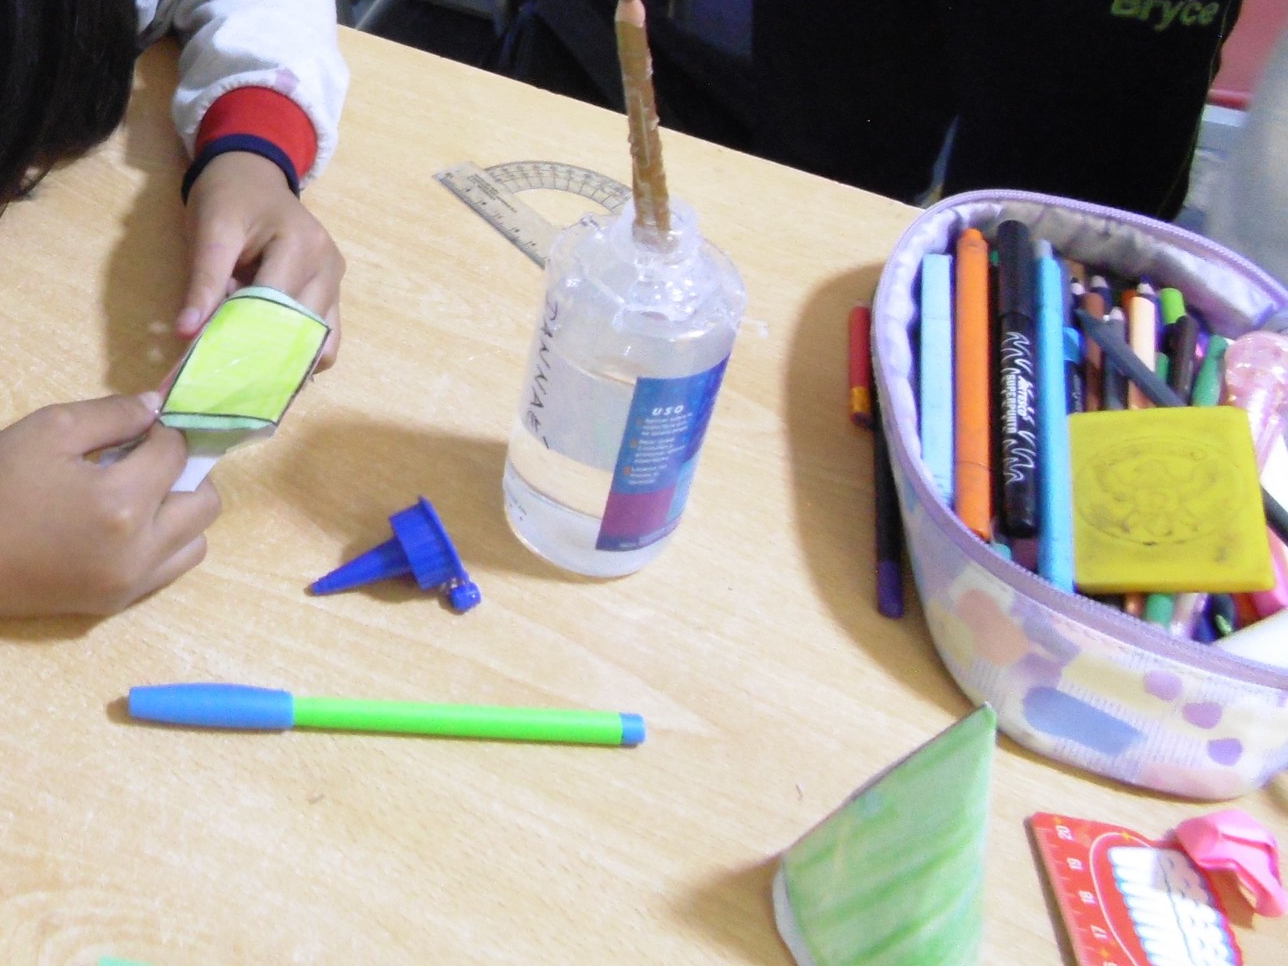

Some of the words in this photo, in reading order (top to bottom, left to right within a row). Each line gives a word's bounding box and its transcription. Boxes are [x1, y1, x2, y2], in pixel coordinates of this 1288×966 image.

[652, 405, 684, 416] USO
[1056, 826, 1073, 840] 20
[1067, 858, 1082, 871] 19
[1079, 891, 1096, 904] 18
[1091, 925, 1107, 938] 17
